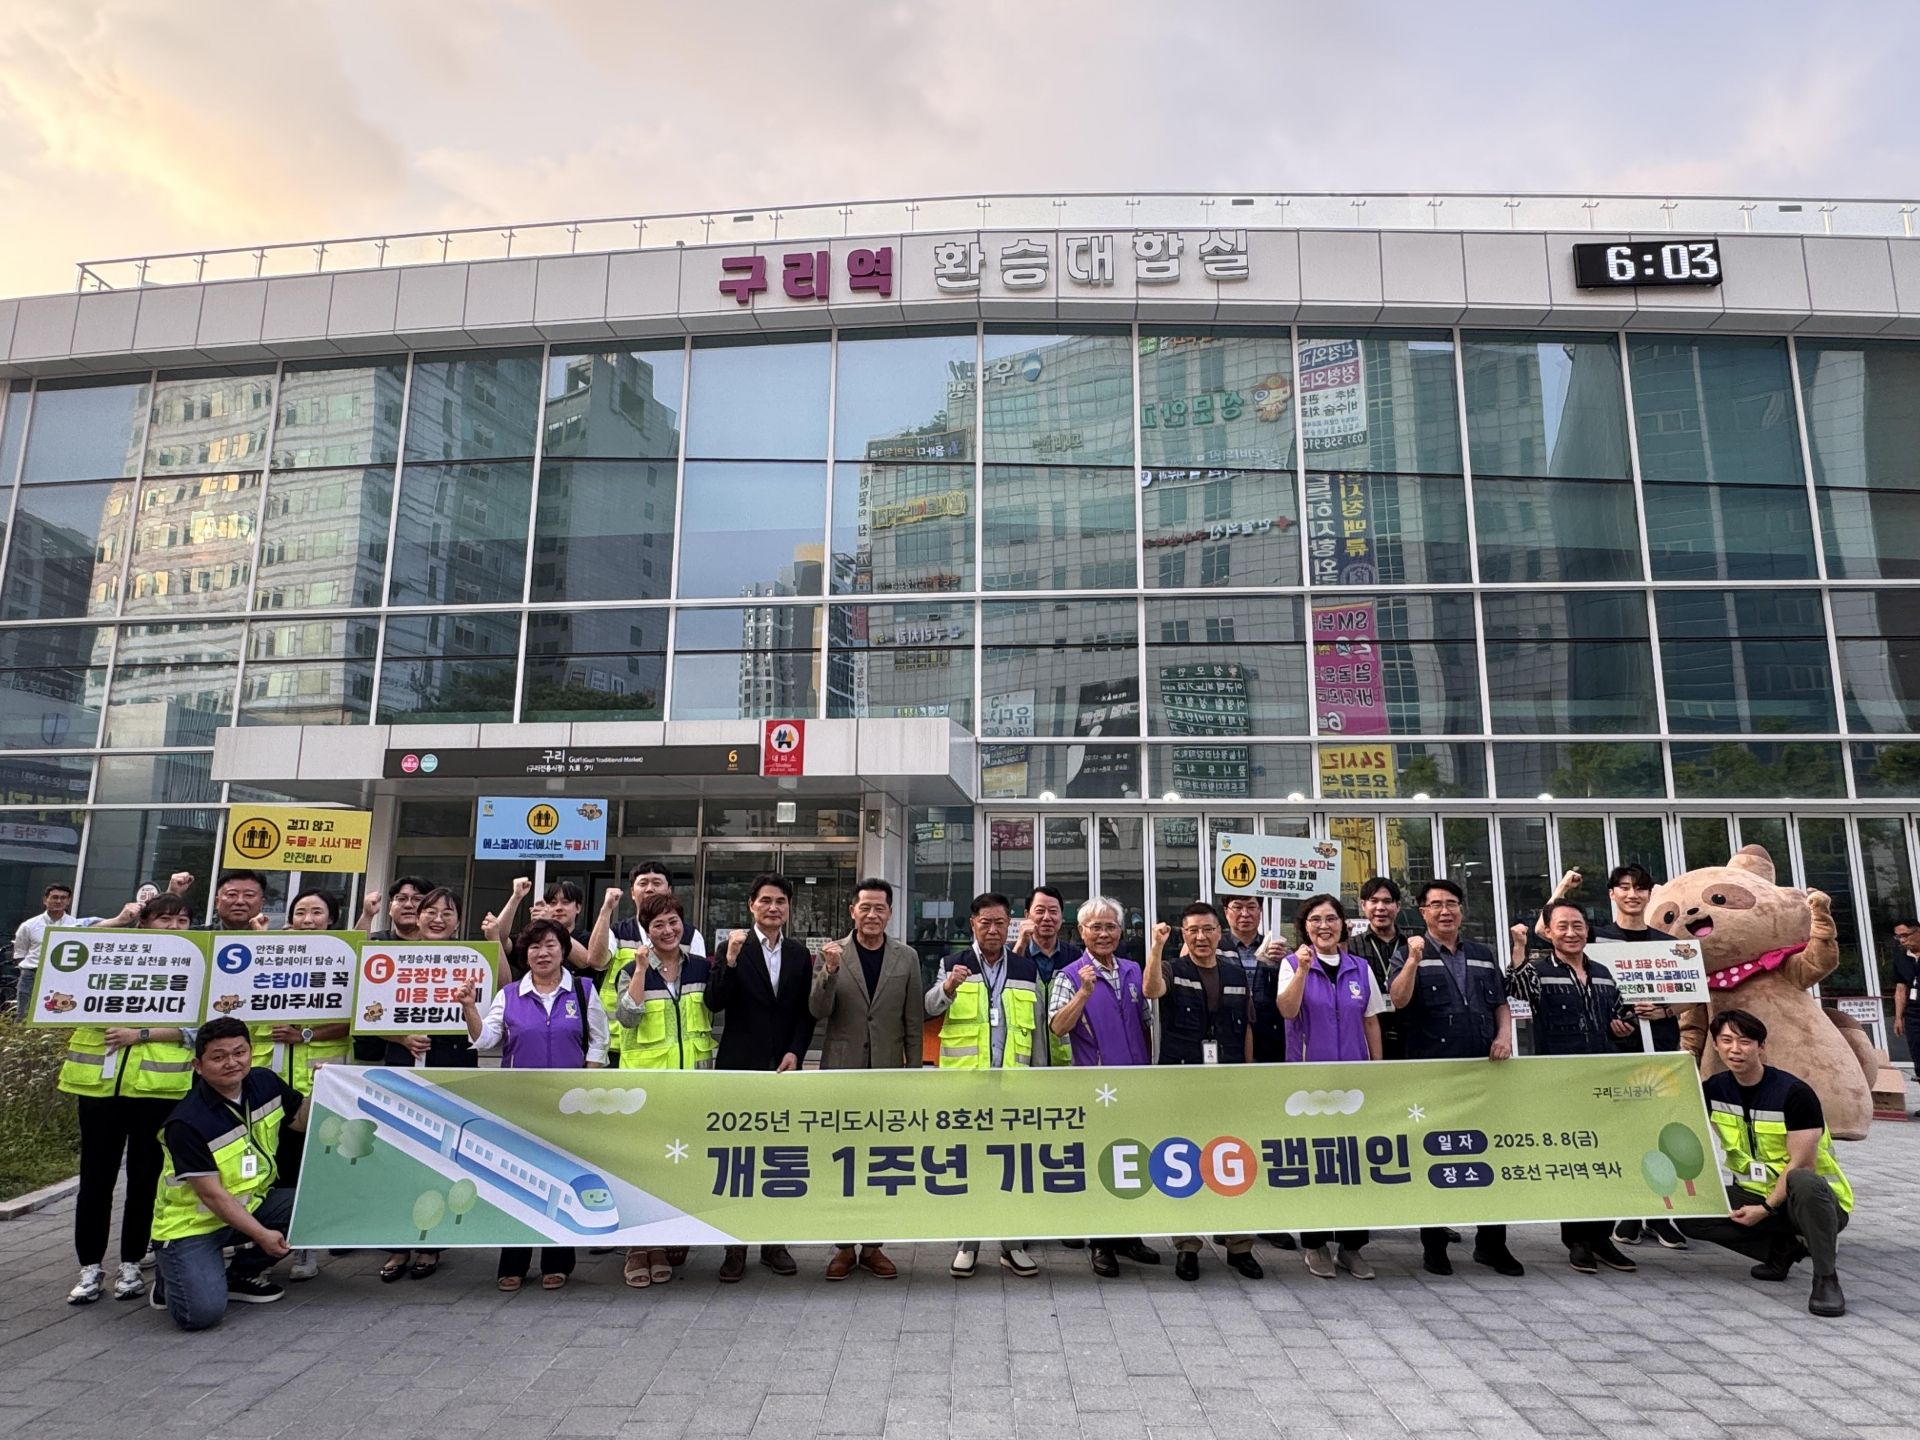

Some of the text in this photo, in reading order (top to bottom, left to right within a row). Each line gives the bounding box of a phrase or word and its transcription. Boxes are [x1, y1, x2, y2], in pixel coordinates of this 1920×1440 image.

[719, 229, 1249, 303] 구리역 환승대합실
[1607, 243, 1718, 280] 6:03
[542, 750, 565, 763] 구리
[728, 750, 738, 763] 6
[287, 819, 334, 832] 걷지 않고
[286, 836, 362, 849] 두줄로 서서가면
[483, 838, 598, 850] 에스컬레이터에서는 두줄서기
[283, 852, 332, 864] 안전합니다
[1261, 856, 1335, 870] 어린이와 노약자는
[1261, 868, 1317, 880] 보호자와 함께
[1260, 880, 1314, 891] 이용해주세요
[93, 942, 152, 953] 환경 보호 및
[256, 944, 307, 955] 안전을 위해
[60, 944, 80, 966] E
[91, 955, 191, 966] 탄소중립 실천을 위해
[226, 948, 242, 969] S
[255, 956, 345, 966] 에스컬레이터 탑승 시
[398, 954, 478, 963] 부정승차를 예방하고
[370, 958, 388, 980] G
[1615, 959, 1678, 969] 국내 최장 65m
[253, 971, 349, 989] 손잡이를 꼭
[397, 967, 485, 984] 공정한 역사
[1617, 969, 1700, 981] 구리역 에스컬레이터
[87, 973, 188, 991] 대중교통을
[1620, 982, 1697, 994] 안전하게 이용해요!
[251, 993, 342, 1010] 잡아주세요
[395, 987, 429, 1003] 이용
[84, 996, 186, 1013] 이용합시다
[393, 1007, 468, 1023] 동참합시
[1593, 1086, 1654, 1099] 구리도시공사
[706, 1106, 1086, 1132] 2025년 구리도시공사 8호선 구리구간
[707, 1145, 810, 1198] 개통
[832, 1143, 968, 1197] 1주년
[986, 1141, 1087, 1193] 기념
[1261, 1134, 1411, 1188] 캠페인
[1502, 1164, 1541, 1181] 8호선
[1545, 1162, 1589, 1180] 구리역
[1592, 1161, 1622, 1179] 역사
